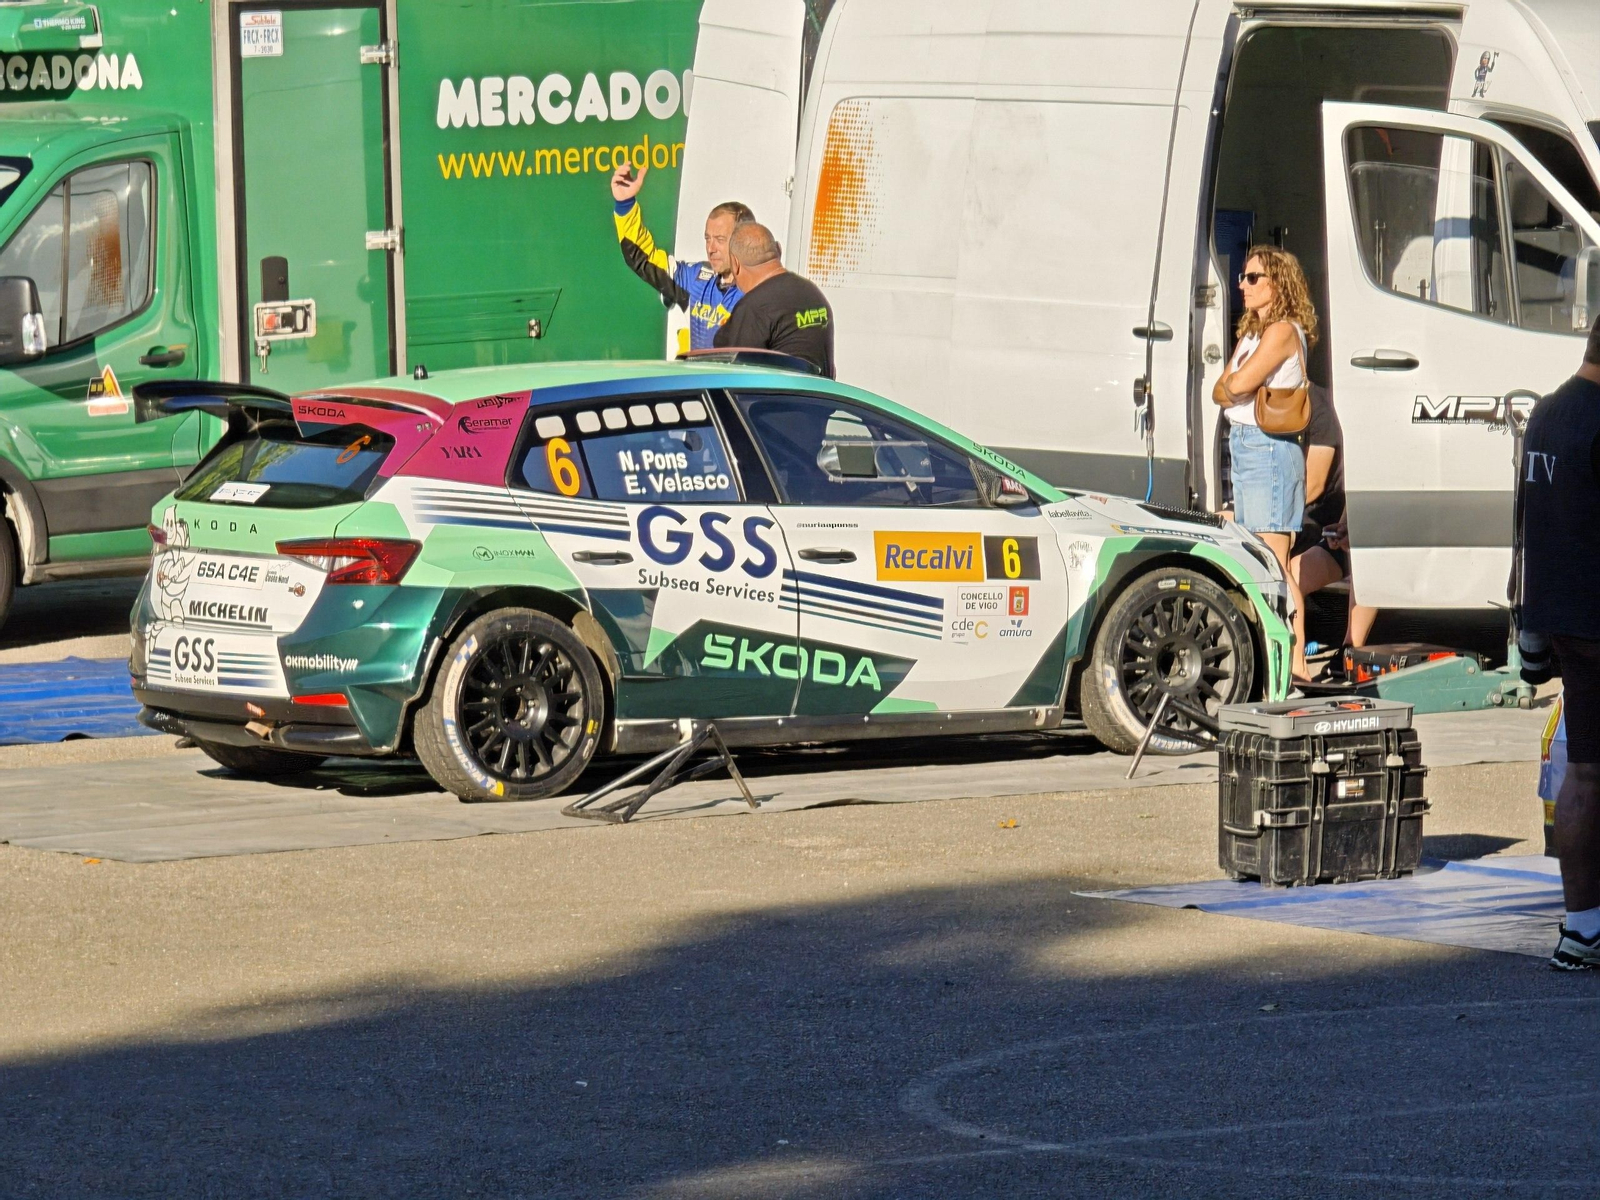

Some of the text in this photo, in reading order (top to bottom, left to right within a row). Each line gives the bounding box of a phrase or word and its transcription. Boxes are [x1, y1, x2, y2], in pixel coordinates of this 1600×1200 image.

[0, 53, 143, 90] CADONA
[795, 307, 828, 327] MPR
[547, 437, 580, 497] 6
[618, 450, 688, 473] N. Pons
[624, 472, 730, 495] E. Velasco
[636, 505, 778, 579] GSS
[884, 543, 974, 570] Recalvi
[1002, 538, 1021, 578] 6
[638, 568, 775, 603] Subsea Services
[961, 592, 1003, 601] CONCELLO
[189, 600, 268, 623] MICHELIN
[965, 602, 998, 610] DE VIGO
[999, 629, 1033, 637] amura
[174, 635, 215, 673] GSS
[701, 633, 881, 692] SKODA
[174, 673, 215, 686] Subsea Services
[1333, 716, 1380, 731] HYUNDAI
